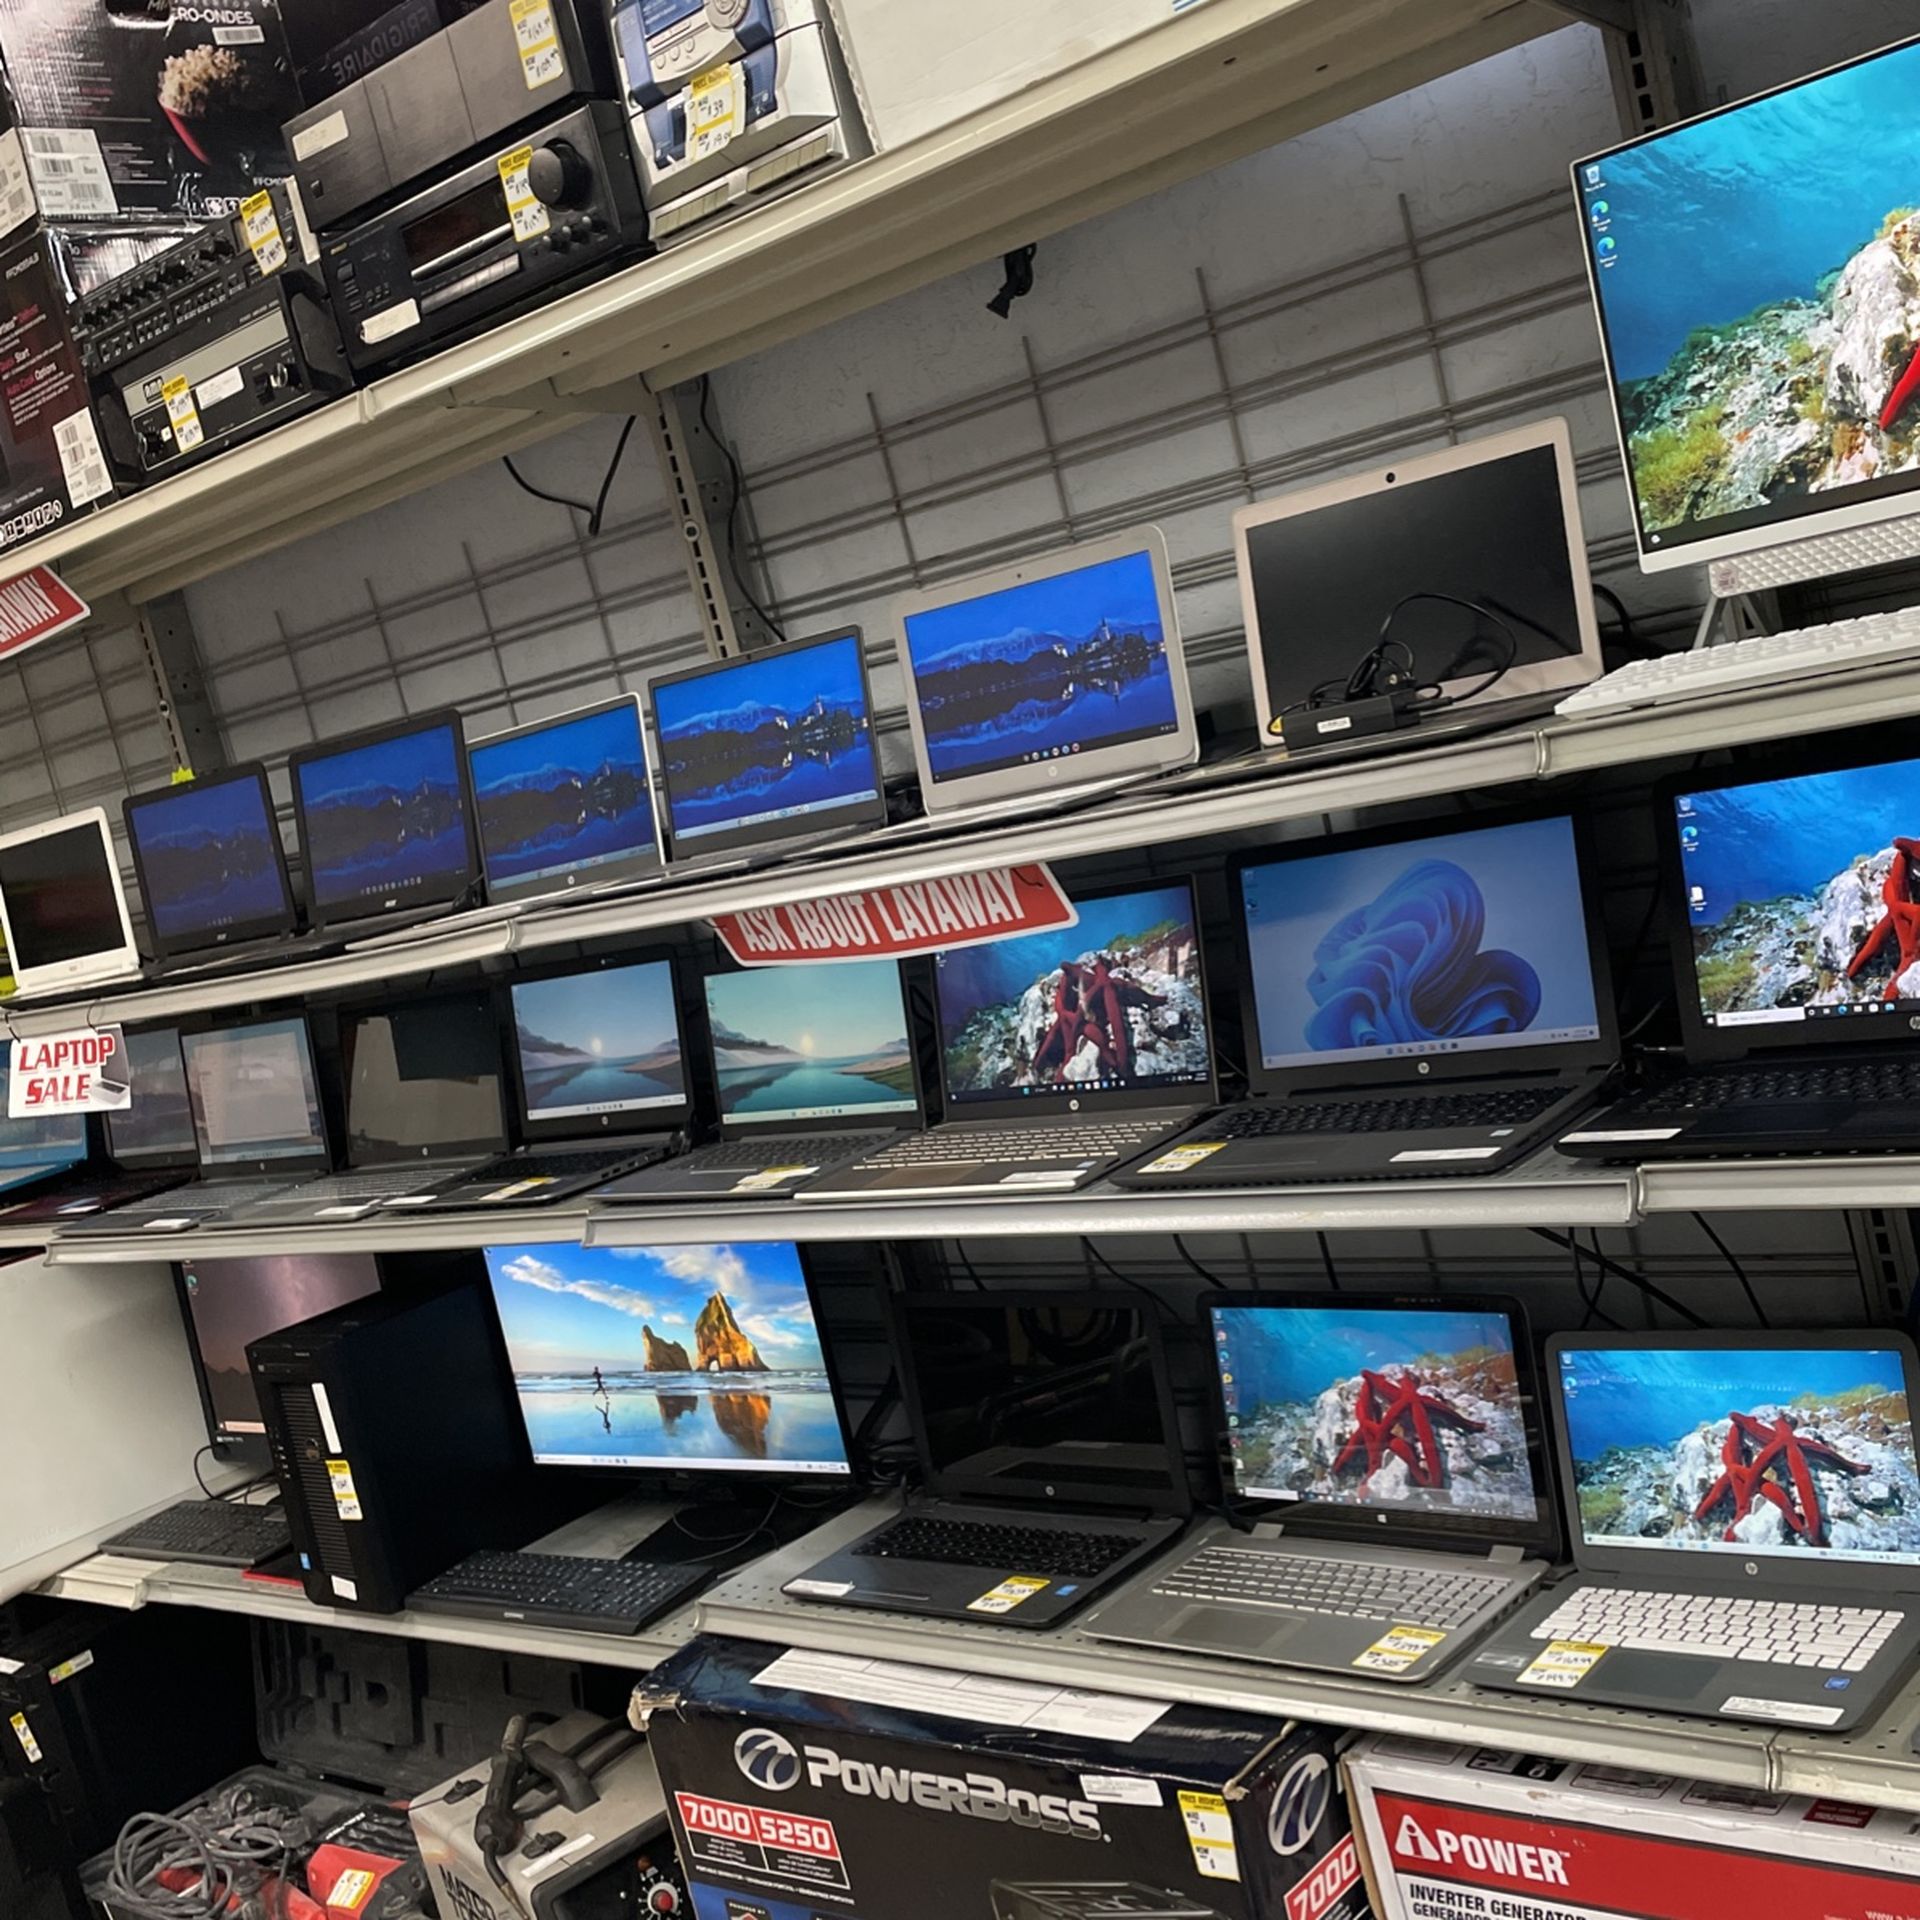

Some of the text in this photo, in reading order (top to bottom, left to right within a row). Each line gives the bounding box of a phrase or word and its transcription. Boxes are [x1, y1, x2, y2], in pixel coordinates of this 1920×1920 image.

[735, 867, 1025, 951] ASK ABOUT LAYAWAY
[18, 1036, 114, 1072] LAPTOP
[25, 1074, 91, 1105] SALE
[684, 1801, 752, 1836] 7000
[759, 1816, 831, 1851] 5250
[1294, 1843, 1356, 1920] 7000
[1410, 1883, 1589, 1920] INVERTER GENERAT
[1413, 1902, 1492, 1920] GENERAD
